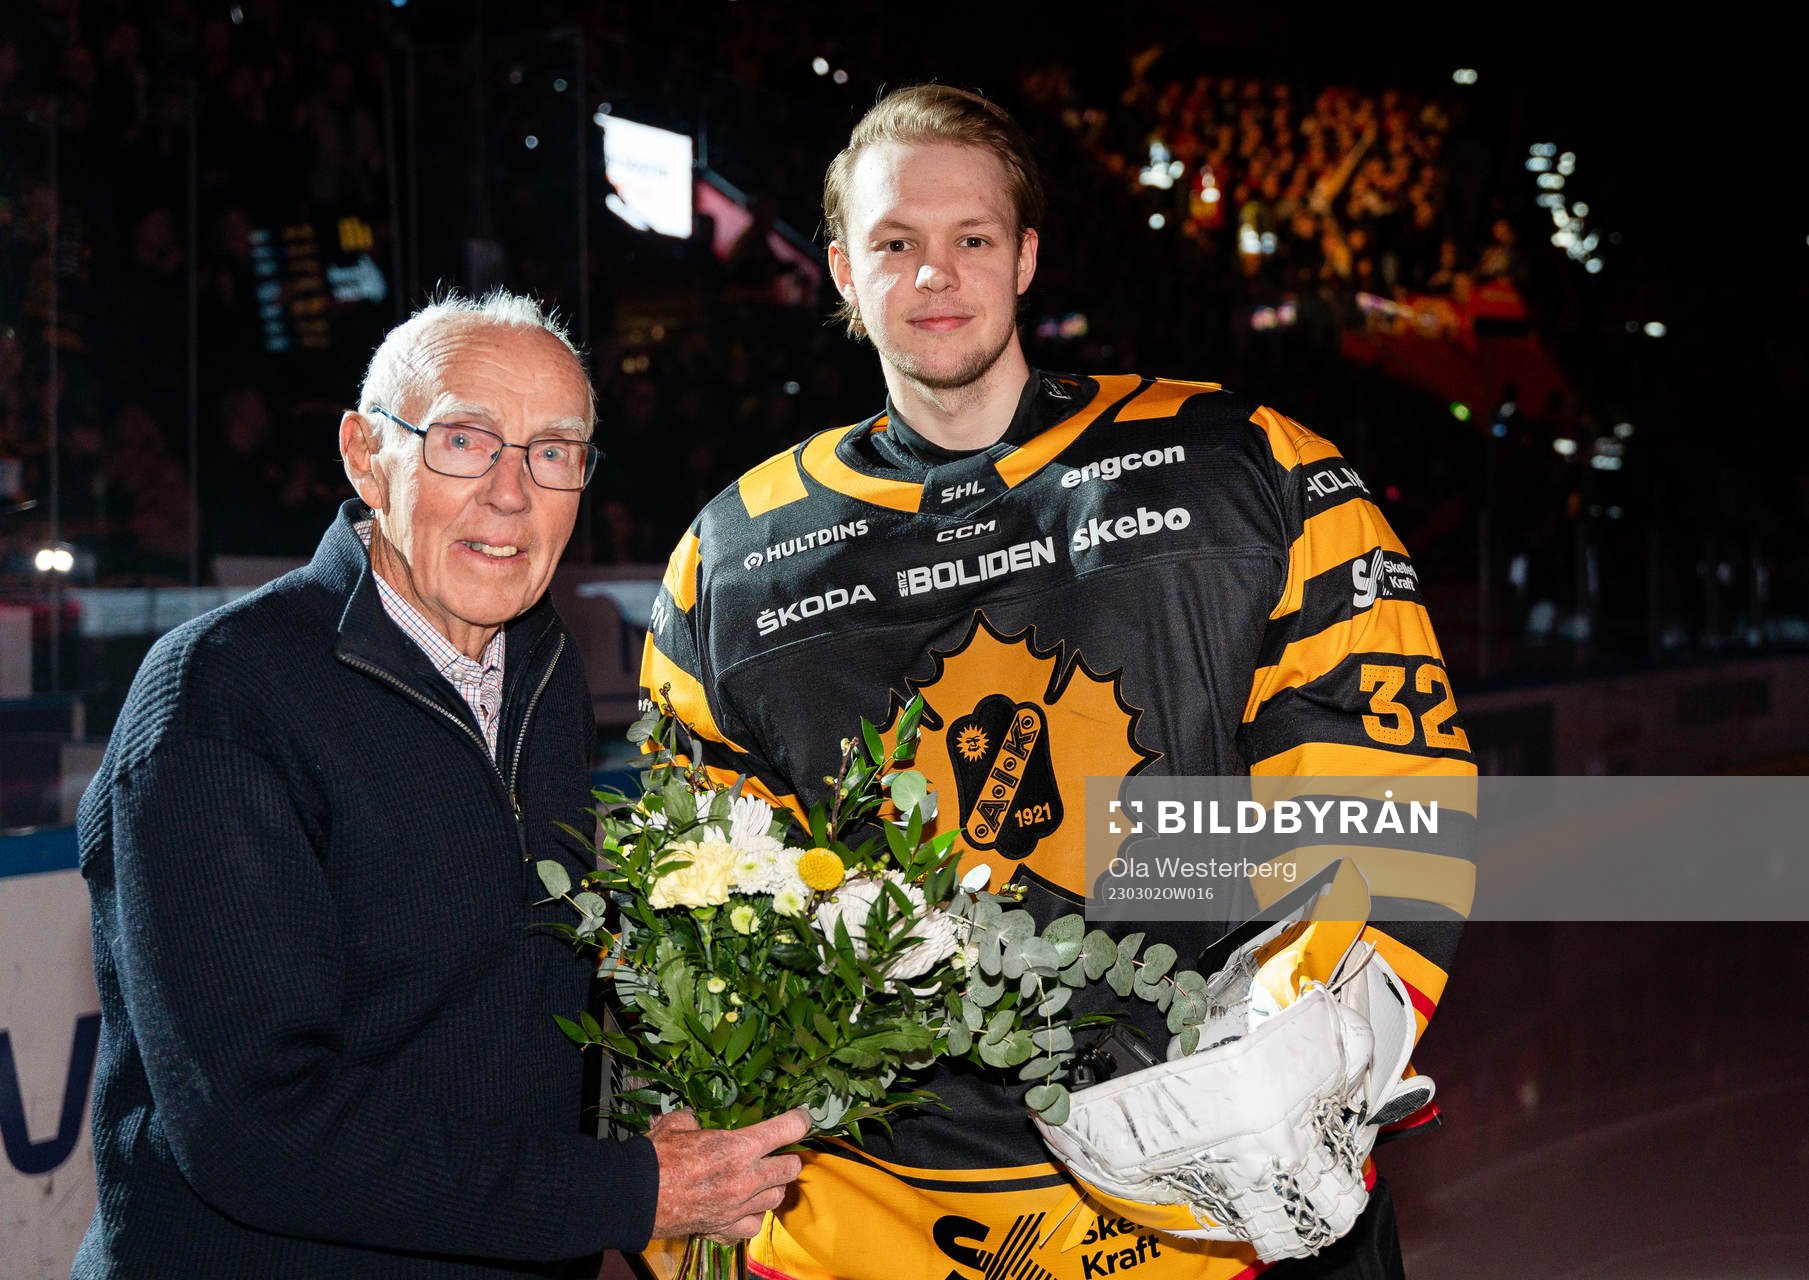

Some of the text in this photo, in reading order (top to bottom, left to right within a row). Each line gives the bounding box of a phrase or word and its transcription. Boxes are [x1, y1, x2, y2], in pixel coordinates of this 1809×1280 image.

[1061, 445, 1186, 490] engcon
[940, 482, 986, 504] SHL
[767, 519, 869, 563] HULTDINS
[936, 519, 997, 543] CCM
[1073, 507, 1191, 552] skebo
[907, 536, 1056, 596] BOLIDEN
[1388, 576, 1416, 592] Kraft
[756, 584, 877, 637] ŠKODA
[1358, 663, 1472, 754] 32
[1014, 801, 1052, 828] 1921
[1081, 1233, 1161, 1280] Kraft
